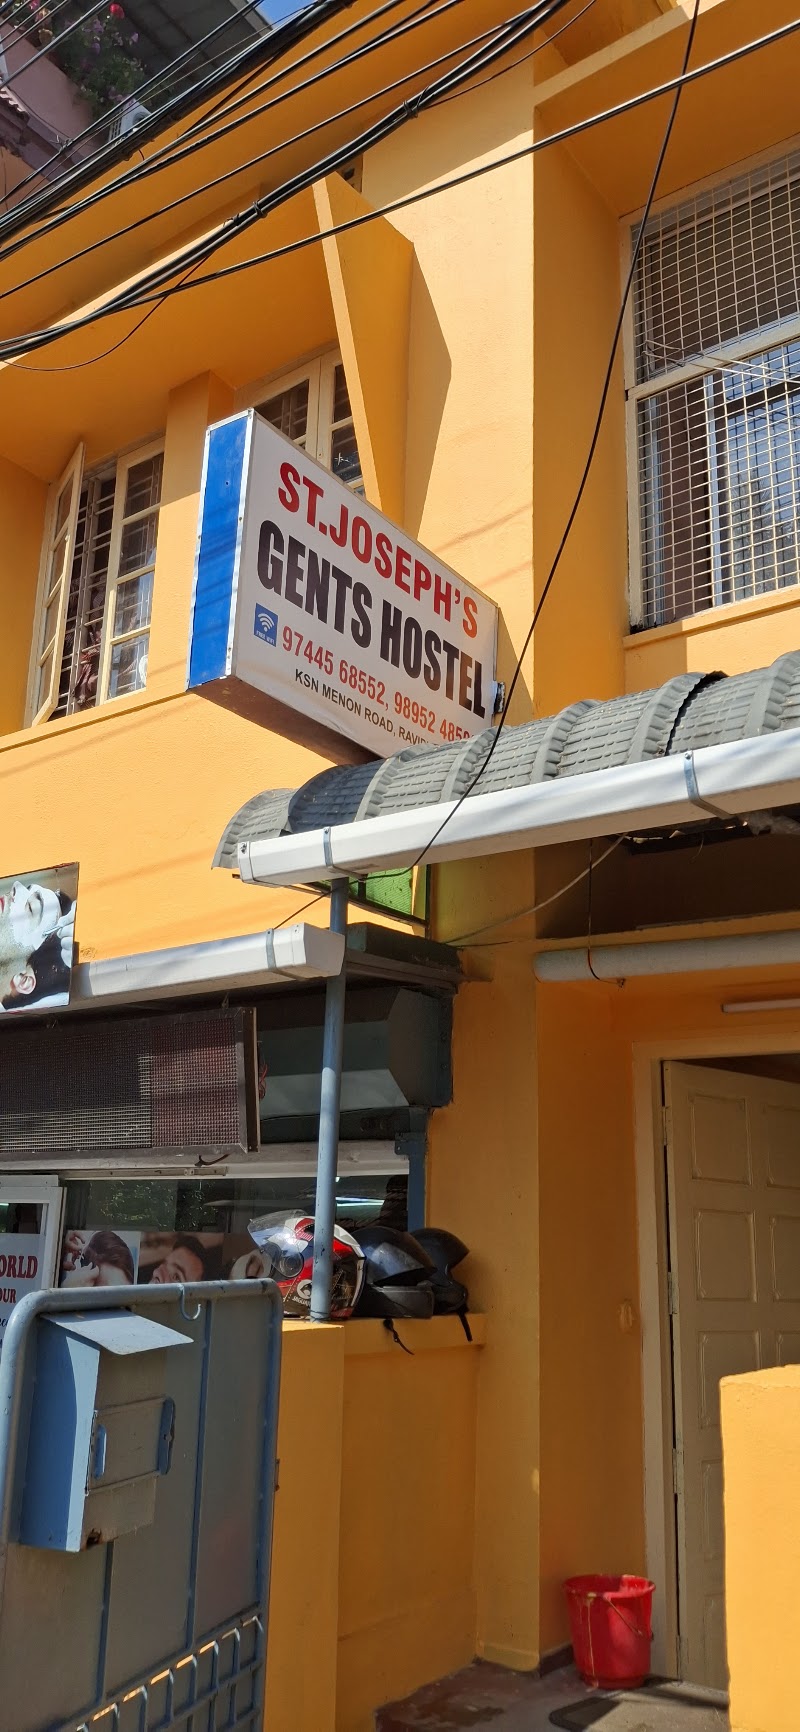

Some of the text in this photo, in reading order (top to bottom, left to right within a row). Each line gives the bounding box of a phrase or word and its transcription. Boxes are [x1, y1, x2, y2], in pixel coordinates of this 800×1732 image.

[256, 519, 486, 719] GENTS HOSTEL
[278, 461, 478, 639] ST.JOSEPH'S
[282, 625, 334, 676] 97445
[339, 658, 389, 711] 68552,
[394, 691, 436, 734] 98952
[295, 668, 319, 693] KSN
[322, 684, 362, 717] MENON
[364, 707, 396, 737] ROAD,
